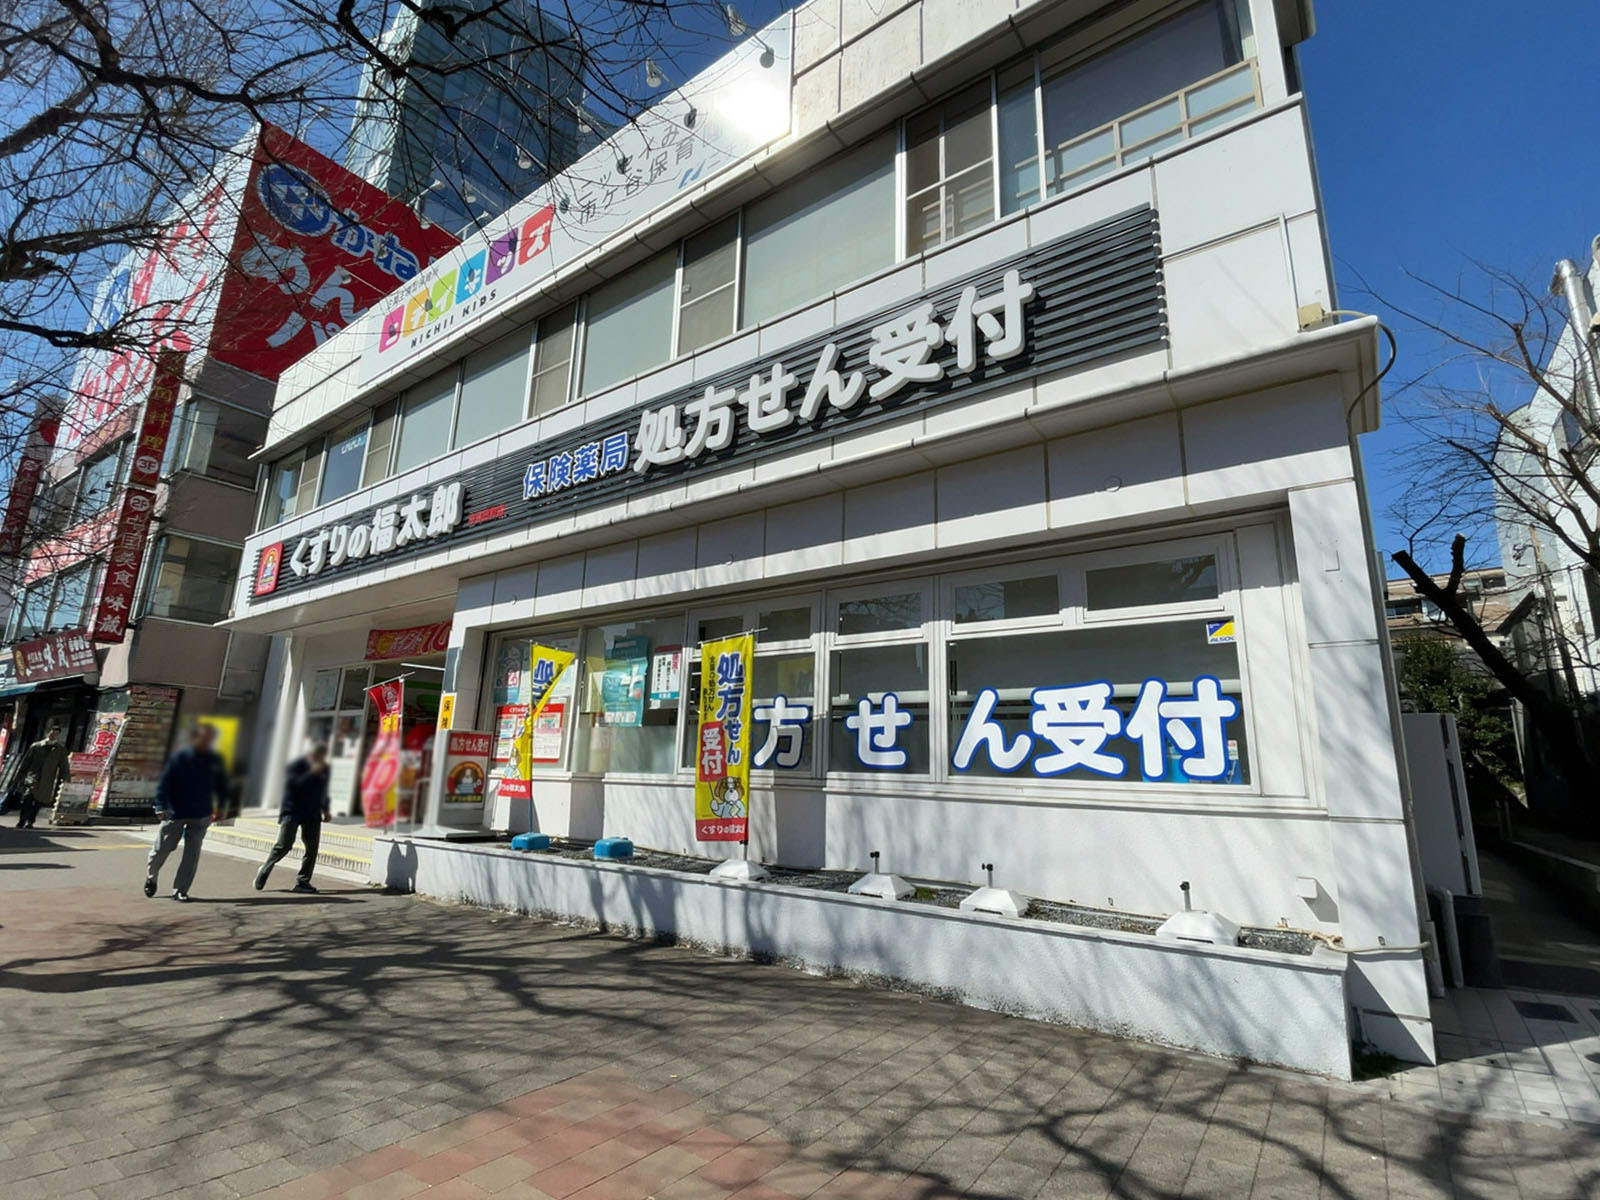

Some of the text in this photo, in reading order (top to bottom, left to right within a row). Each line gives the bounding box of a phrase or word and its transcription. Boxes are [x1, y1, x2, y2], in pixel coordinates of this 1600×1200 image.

[410, 288, 497, 349] NICHII KIDS
[523, 269, 1036, 500] 保険薬局 処方せん受付
[138, 458, 157, 470] 3F
[131, 497, 149, 509] 2F
[290, 482, 465, 577] くすりの福太郎
[716, 652, 744, 766] 処方せん
[702, 727, 723, 775] 受付
